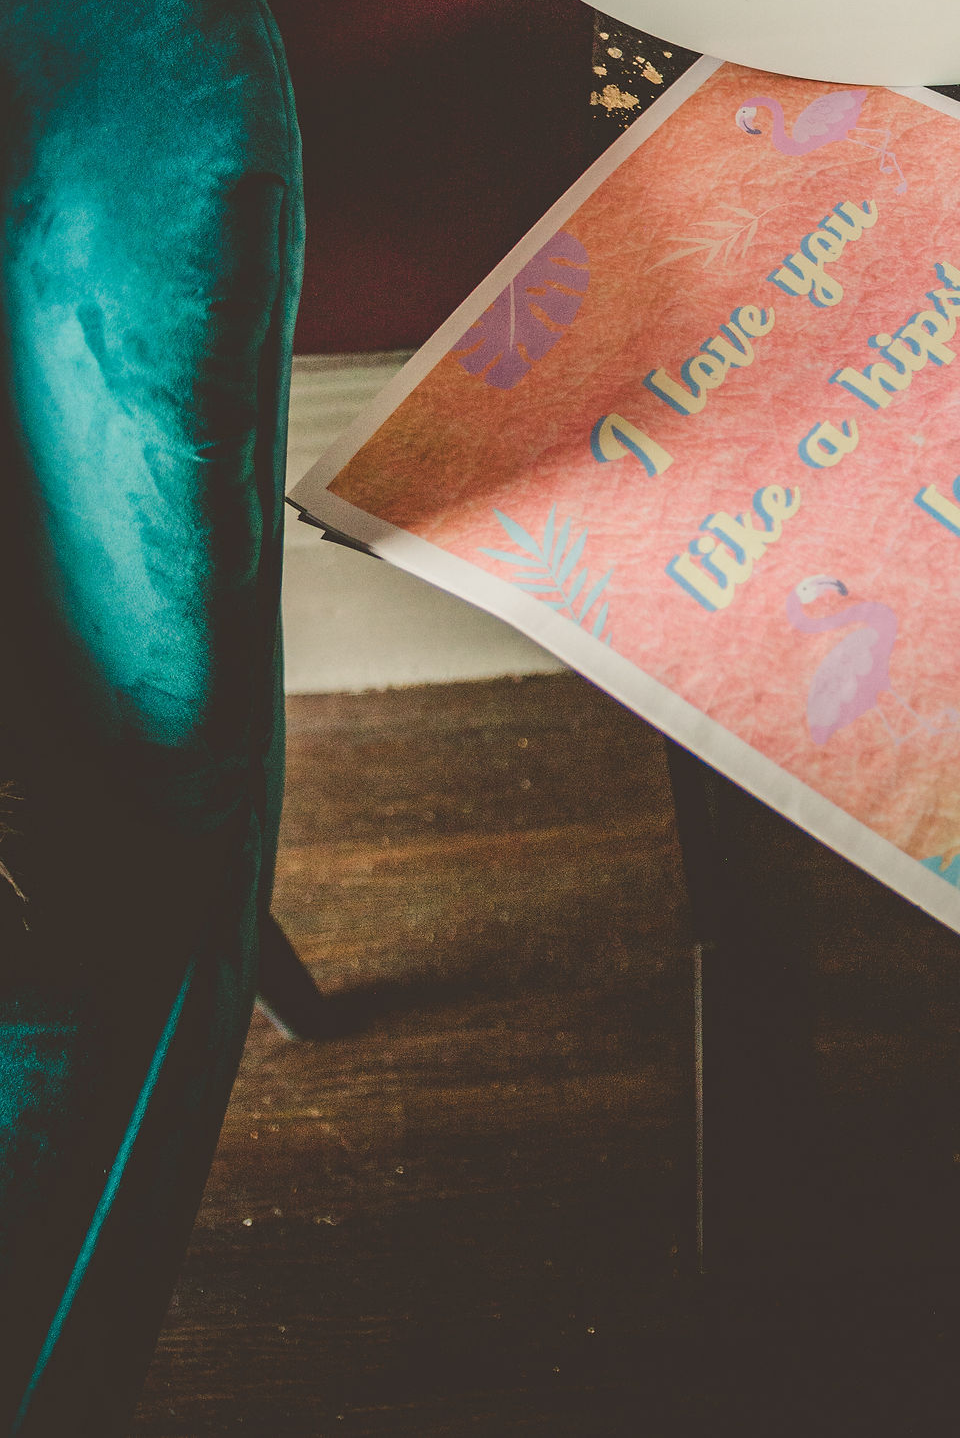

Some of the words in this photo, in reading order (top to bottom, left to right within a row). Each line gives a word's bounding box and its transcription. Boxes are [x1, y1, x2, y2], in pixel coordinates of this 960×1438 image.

[590, 413, 674, 477] I
[644, 303, 775, 416] love
[768, 199, 879, 308] you
[665, 484, 801, 612] like
[799, 417, 859, 469] a
